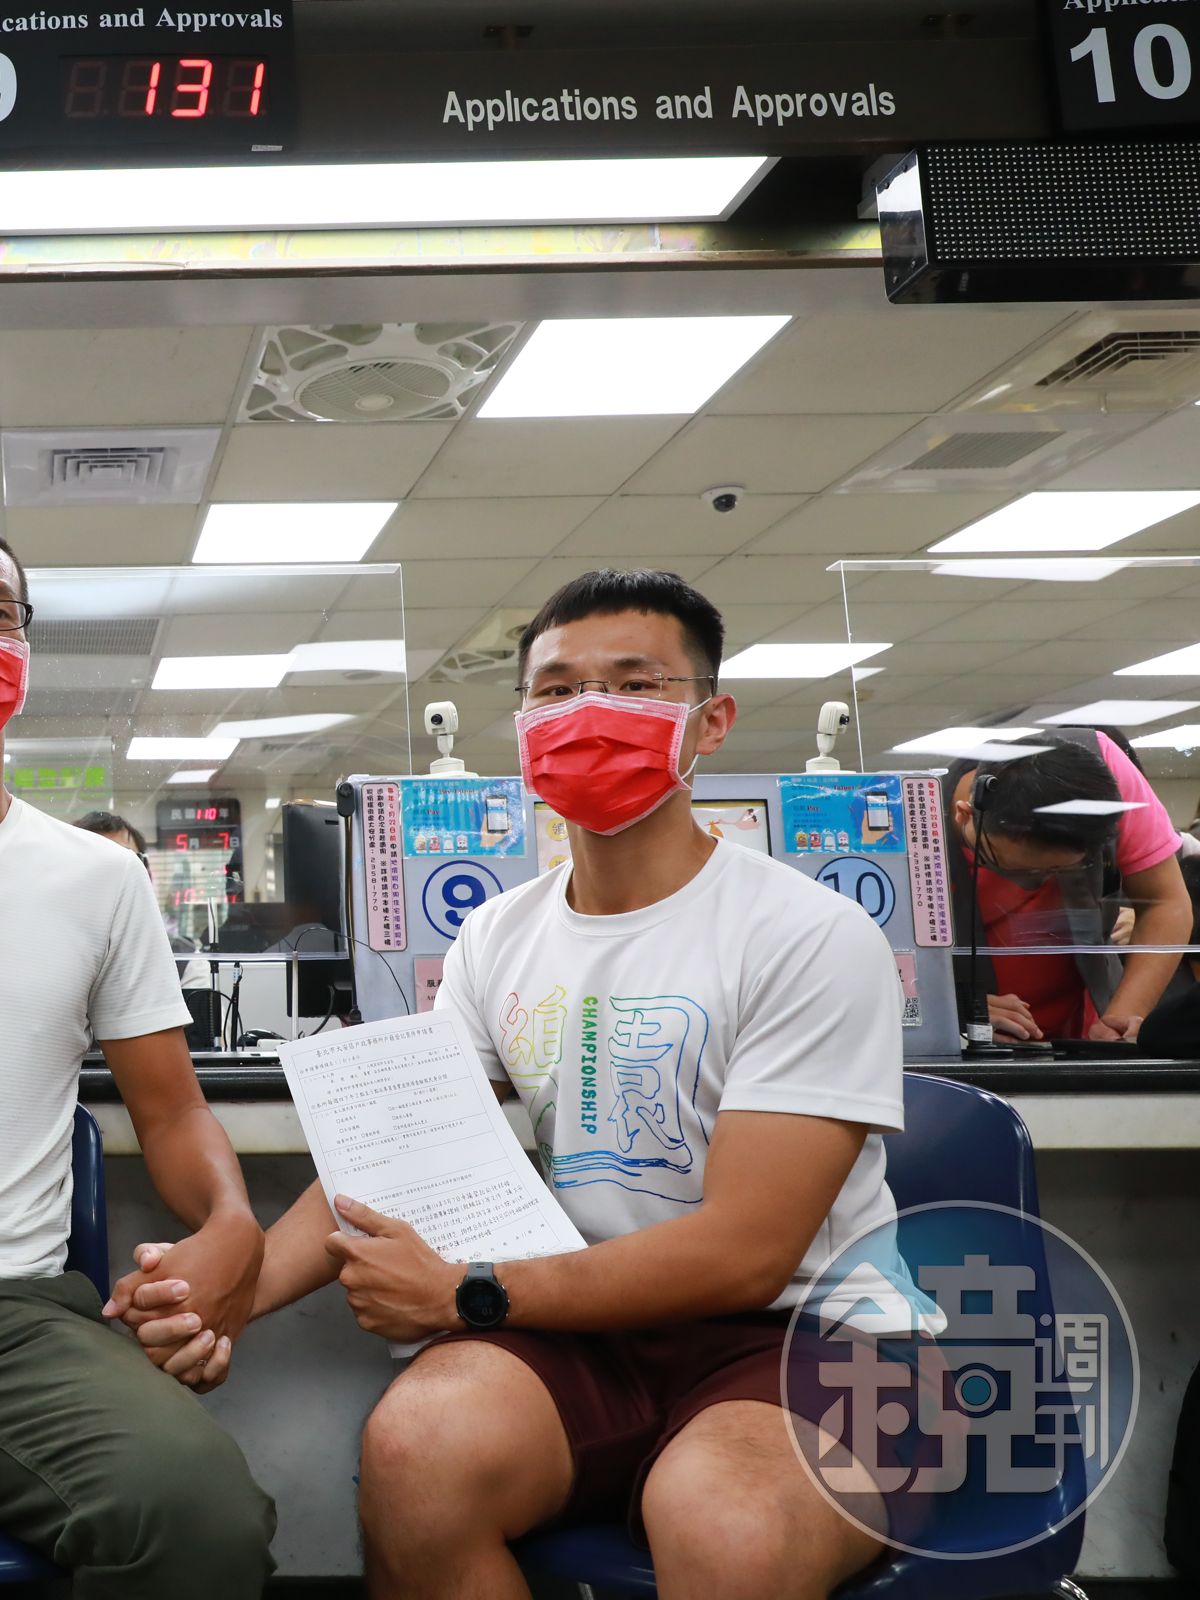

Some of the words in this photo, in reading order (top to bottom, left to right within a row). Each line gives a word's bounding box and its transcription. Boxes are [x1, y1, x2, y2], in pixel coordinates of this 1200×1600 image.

[99, 8, 146, 29] and
[155, 7, 284, 32] Approvals
[145, 59, 265, 117] 131
[1069, 23, 1192, 103] 10
[442, 89, 638, 131] Applications
[655, 85, 712, 120] and
[731, 83, 897, 126] Approvals
[442, 874, 487, 927] 9
[580, 996, 599, 1135] CHAMPIONSHIP
